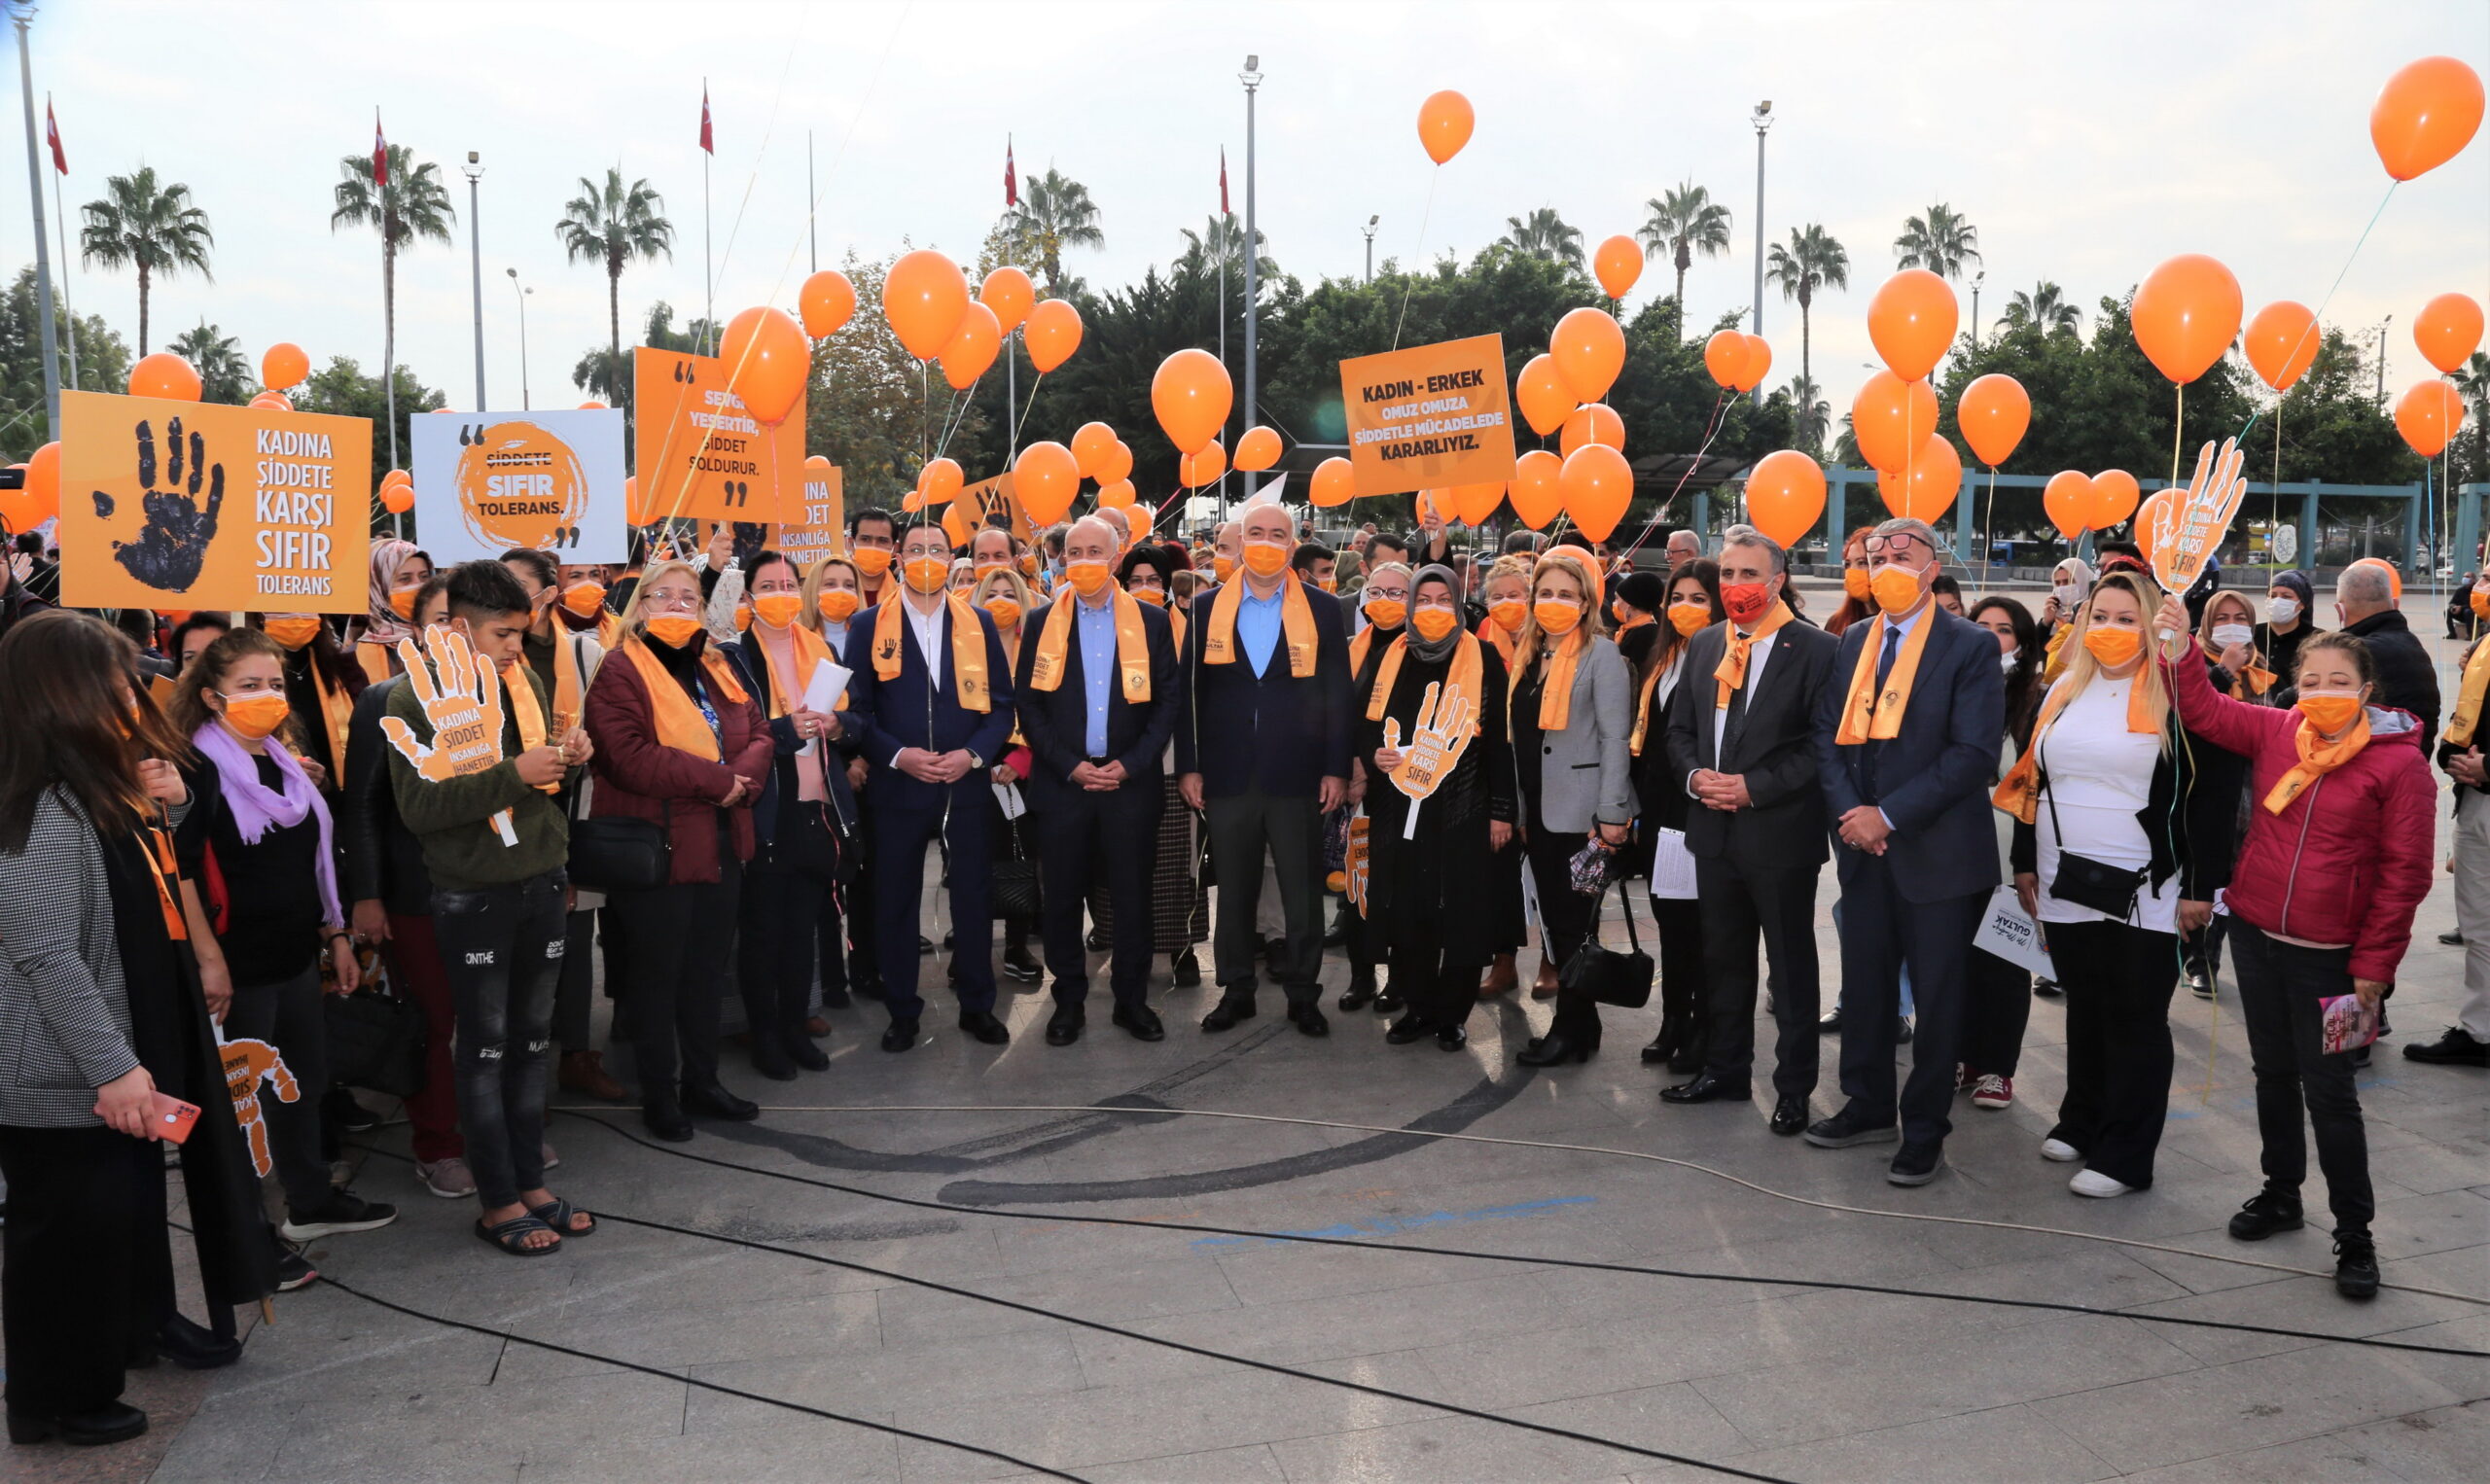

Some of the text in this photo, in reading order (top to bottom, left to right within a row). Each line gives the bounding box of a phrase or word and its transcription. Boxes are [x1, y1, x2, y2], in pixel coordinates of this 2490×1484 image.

[1363, 380, 1413, 403] KADIN
[1427, 369, 1484, 393] ERKEK
[1382, 396, 1469, 420] OMUZ OMUZA
[1355, 412, 1504, 446] ŞİDDETLE MÜCADELEDE
[257, 428, 333, 459] KADINA
[703, 434, 747, 453] ŞİDDET
[1381, 435, 1479, 460] KARARLIYIZ.
[486, 451, 551, 469] ŞİDDETE
[689, 455, 760, 477] SOLDURUR.
[257, 457, 334, 489] ŞİDDETE
[487, 474, 554, 497] SIFIR
[805, 481, 830, 500] INA
[256, 489, 333, 531] KARŞI
[478, 501, 564, 515] TOLERANS.
[805, 505, 830, 525] DET
[256, 530, 332, 571] SIFIR
[2171, 553, 2196, 573] SFIR
[256, 575, 332, 596] TOLERANS
[438, 708, 482, 730] KADINA
[444, 724, 485, 749] ŞİDDET
[1419, 734, 1443, 751] KADINA
[1410, 754, 1438, 773] KARŞI
[1405, 766, 1432, 786] SIFIR
